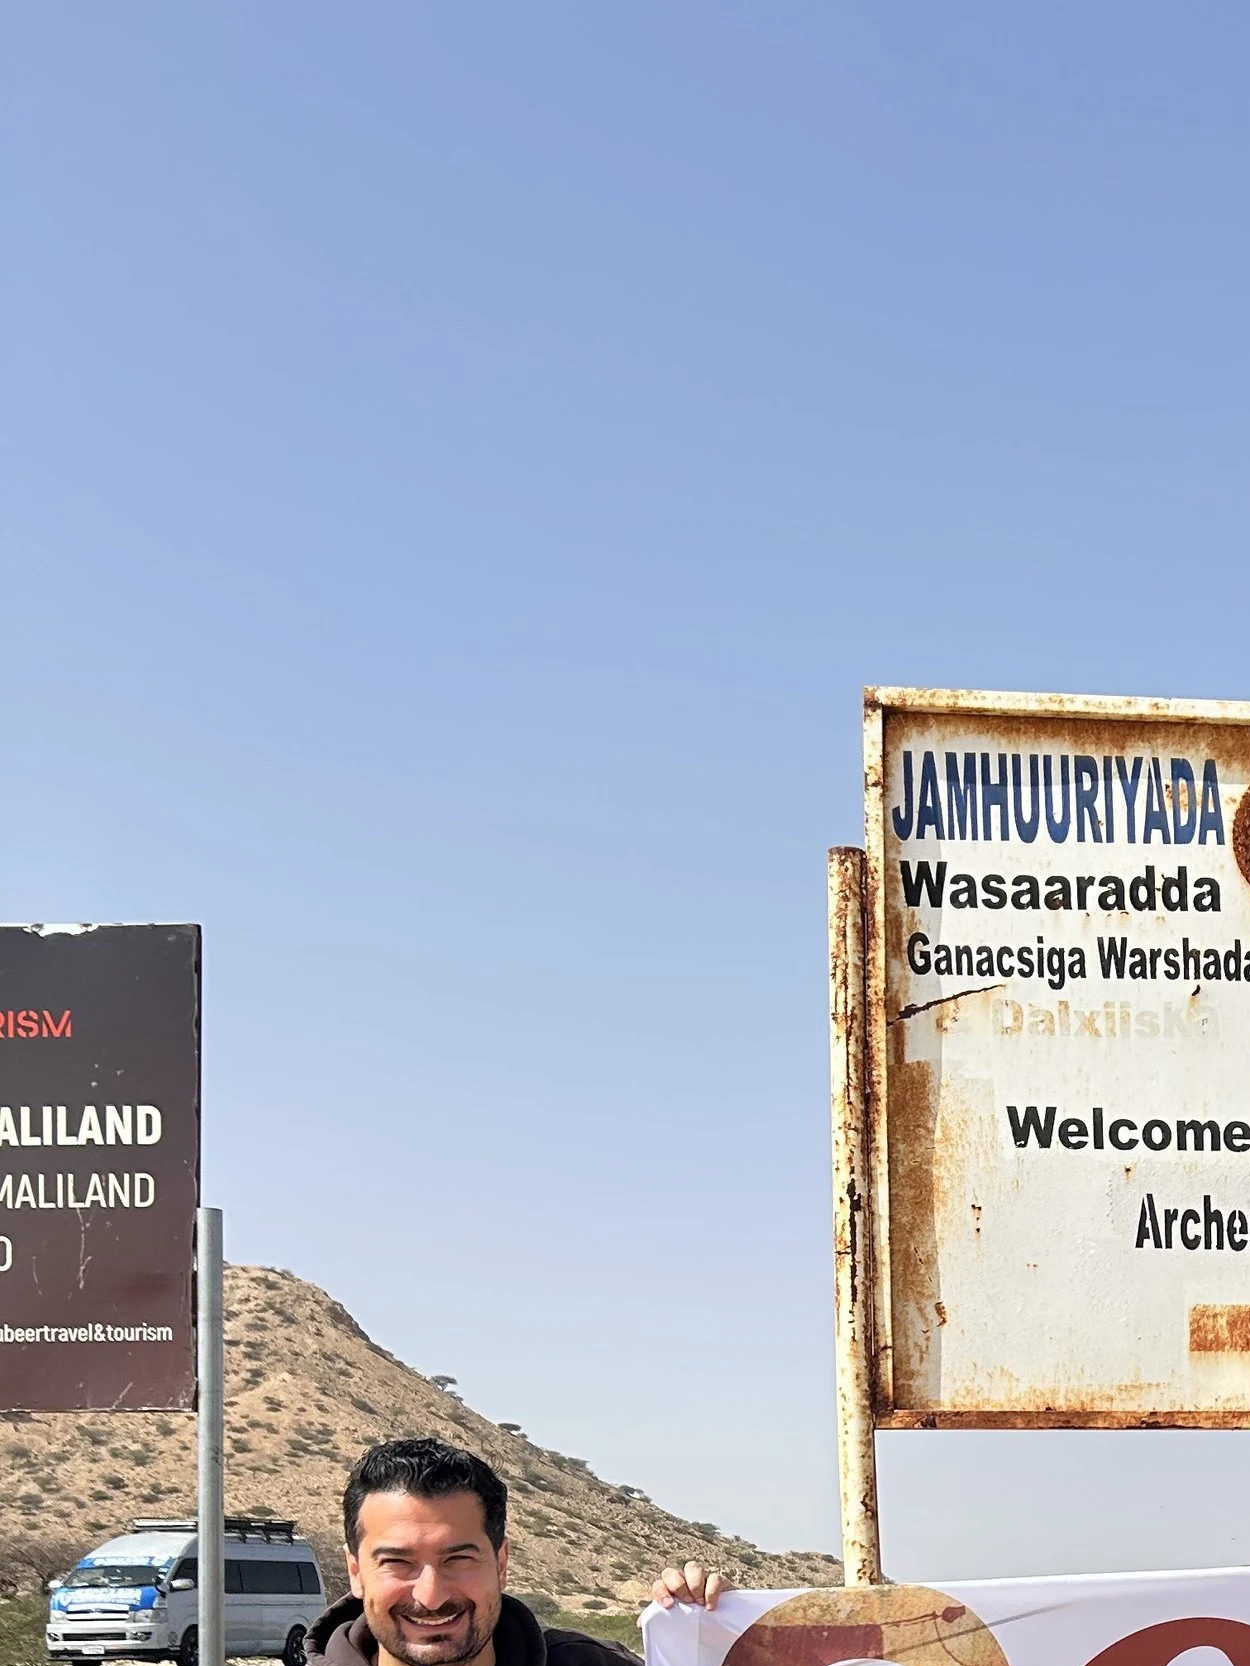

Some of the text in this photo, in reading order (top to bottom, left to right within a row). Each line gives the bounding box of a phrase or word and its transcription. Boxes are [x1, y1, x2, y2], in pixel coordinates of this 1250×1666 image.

[892, 749, 1226, 846] JAMHUURIYADA
[898, 860, 1222, 913] Wasaaradda
[906, 931, 1087, 991] Ganacsiga
[0, 1009, 73, 1038] ISM
[0, 1104, 162, 1147] ALILAND
